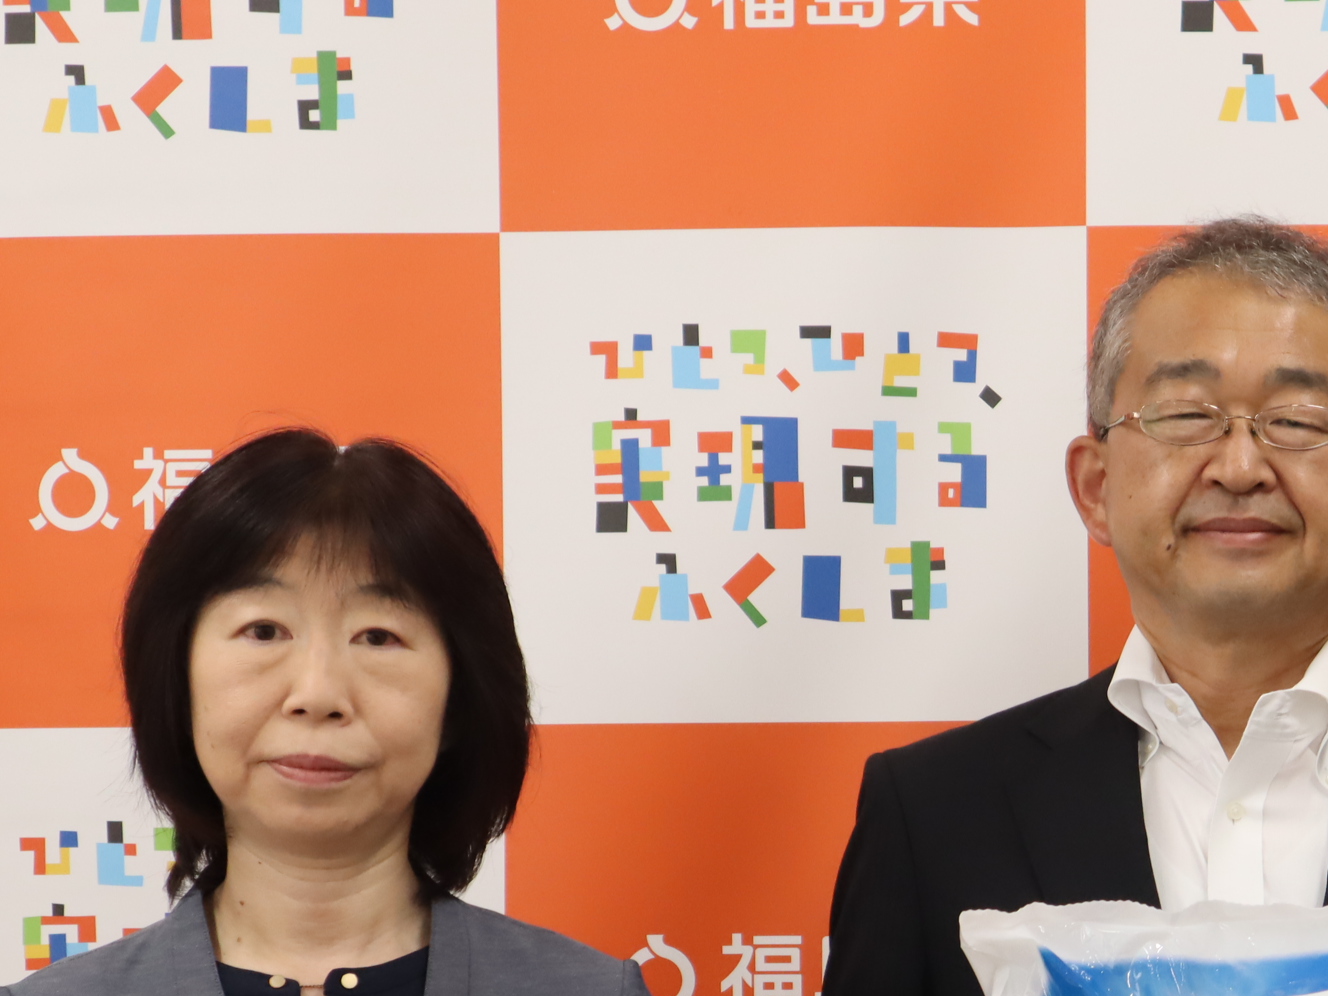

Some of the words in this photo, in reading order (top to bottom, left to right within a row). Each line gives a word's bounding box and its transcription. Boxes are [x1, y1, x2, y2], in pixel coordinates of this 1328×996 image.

[42, 50, 356, 140] ふくしま
[592, 407, 988, 533] 実現する
[632, 541, 948, 629] ふくしま
